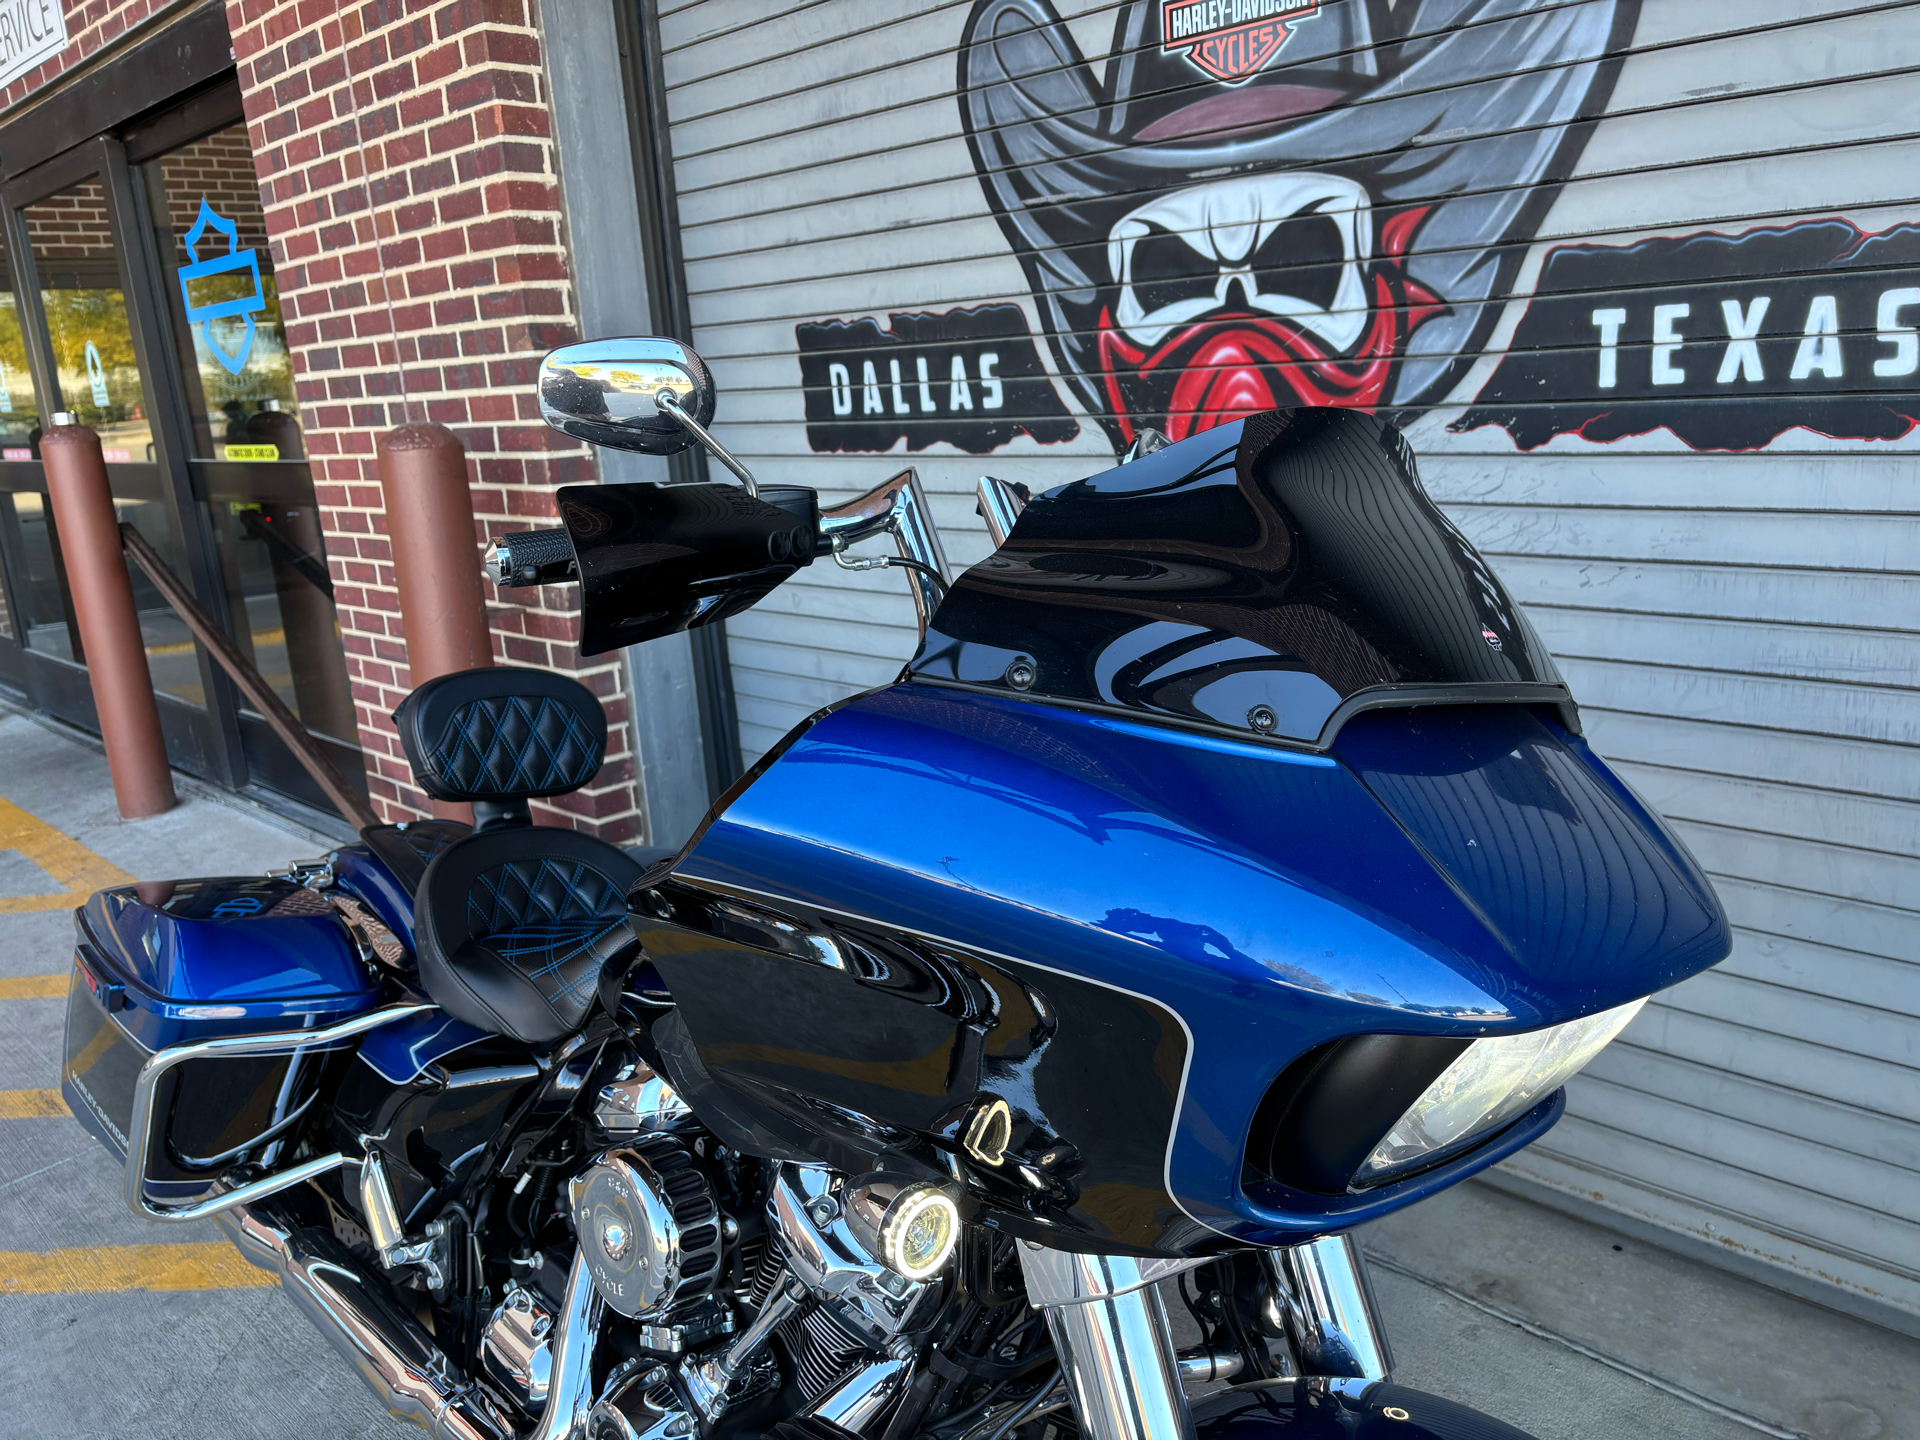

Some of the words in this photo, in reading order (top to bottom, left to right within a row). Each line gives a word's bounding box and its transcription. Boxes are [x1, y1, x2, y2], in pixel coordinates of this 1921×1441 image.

[0, 0, 54, 67] RVICE
[1202, 26, 1273, 74] CYCLES
[1592, 287, 1920, 388] TEXAS
[829, 353, 1004, 415] DALLAS
[594, 1264, 625, 1297] CYCLE
